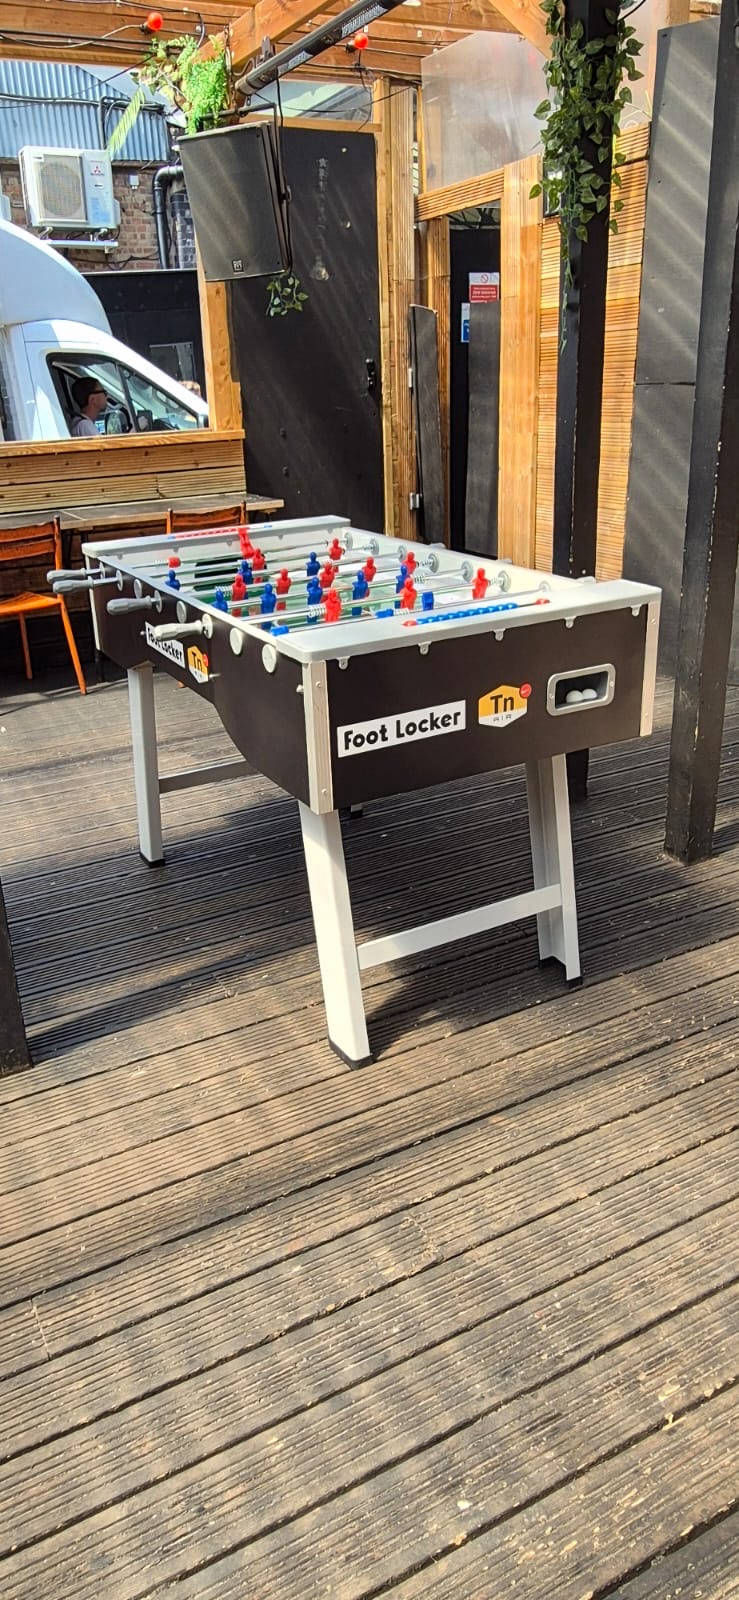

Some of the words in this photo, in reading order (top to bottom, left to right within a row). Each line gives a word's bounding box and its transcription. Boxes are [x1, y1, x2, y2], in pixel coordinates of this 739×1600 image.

[490, 694, 515, 714] Tn
[344, 724, 388, 750] Foot
[395, 711, 461, 739] Locker
